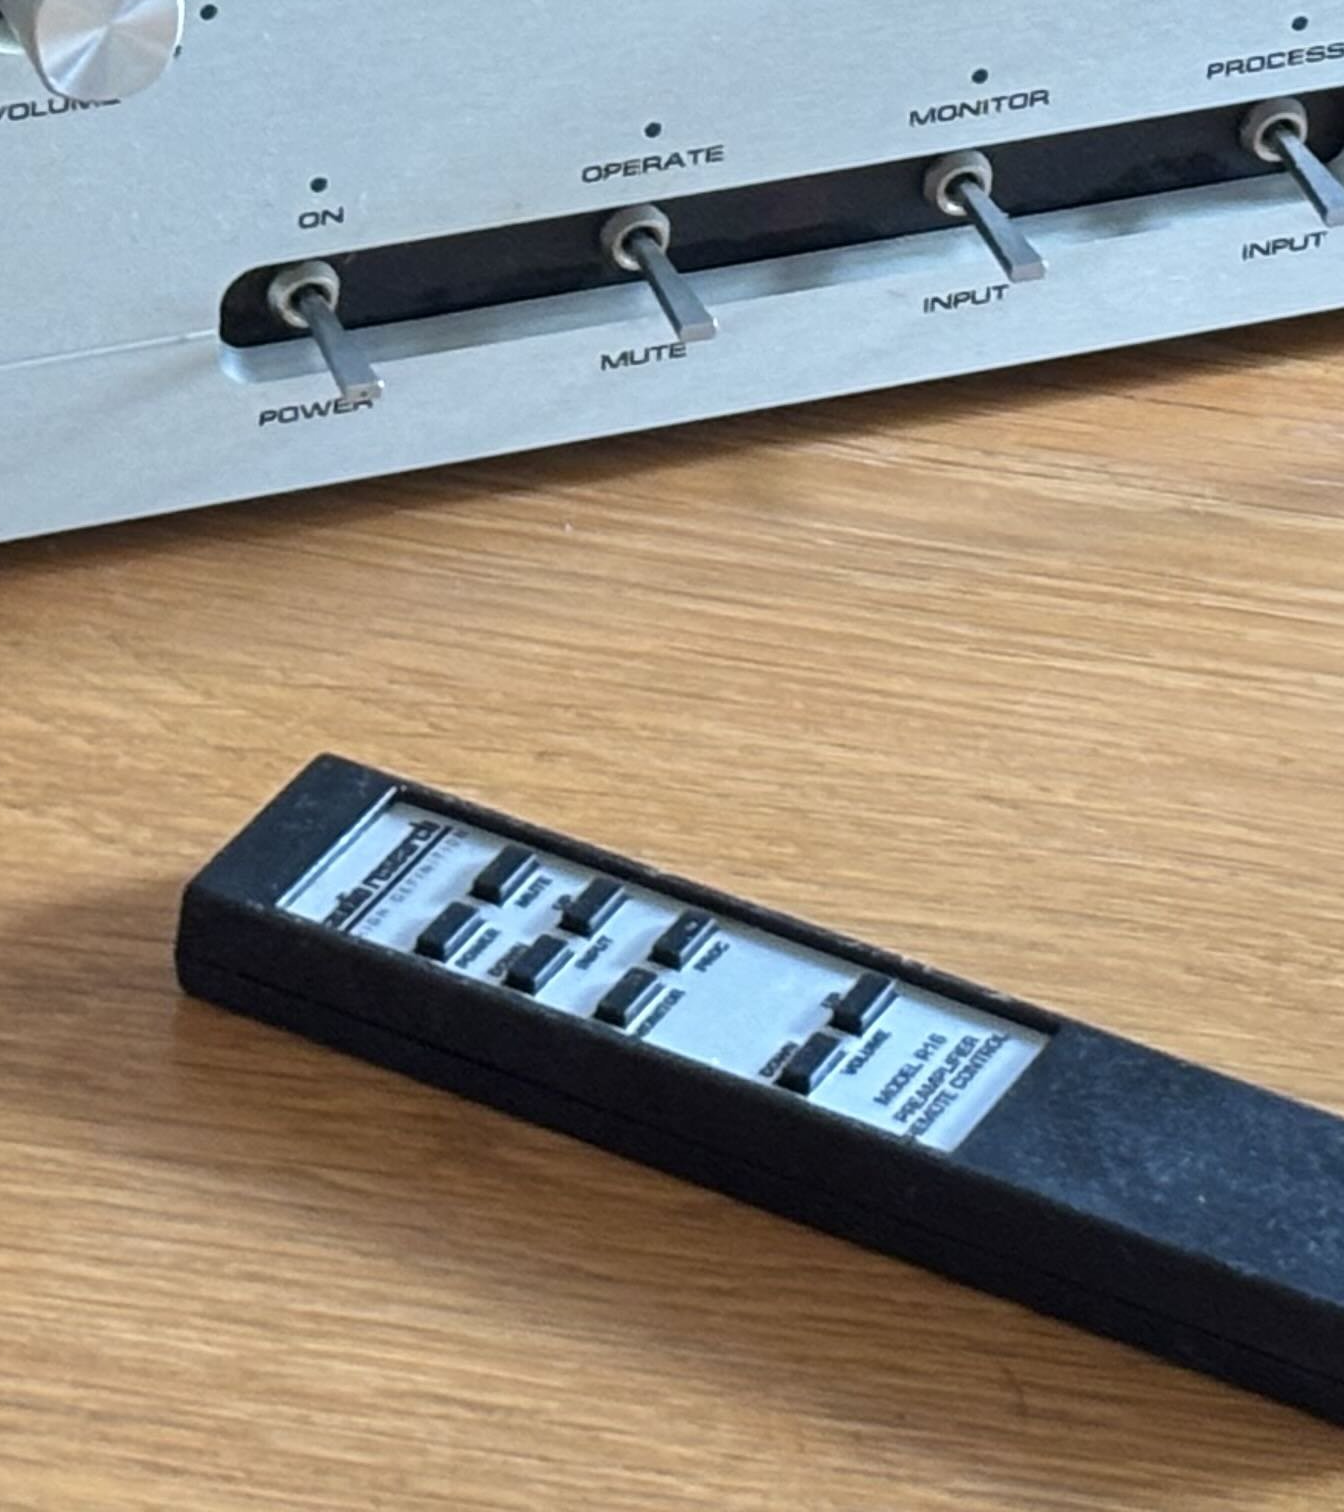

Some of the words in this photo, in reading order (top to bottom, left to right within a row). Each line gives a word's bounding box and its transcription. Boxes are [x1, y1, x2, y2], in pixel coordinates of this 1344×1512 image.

[908, 89, 1050, 128] MONITOR
[581, 144, 725, 184] OPERATE
[298, 206, 345, 230] ON
[1242, 231, 1327, 261] INPUT
[923, 284, 1010, 314] INPUT
[601, 342, 688, 371] MUTE
